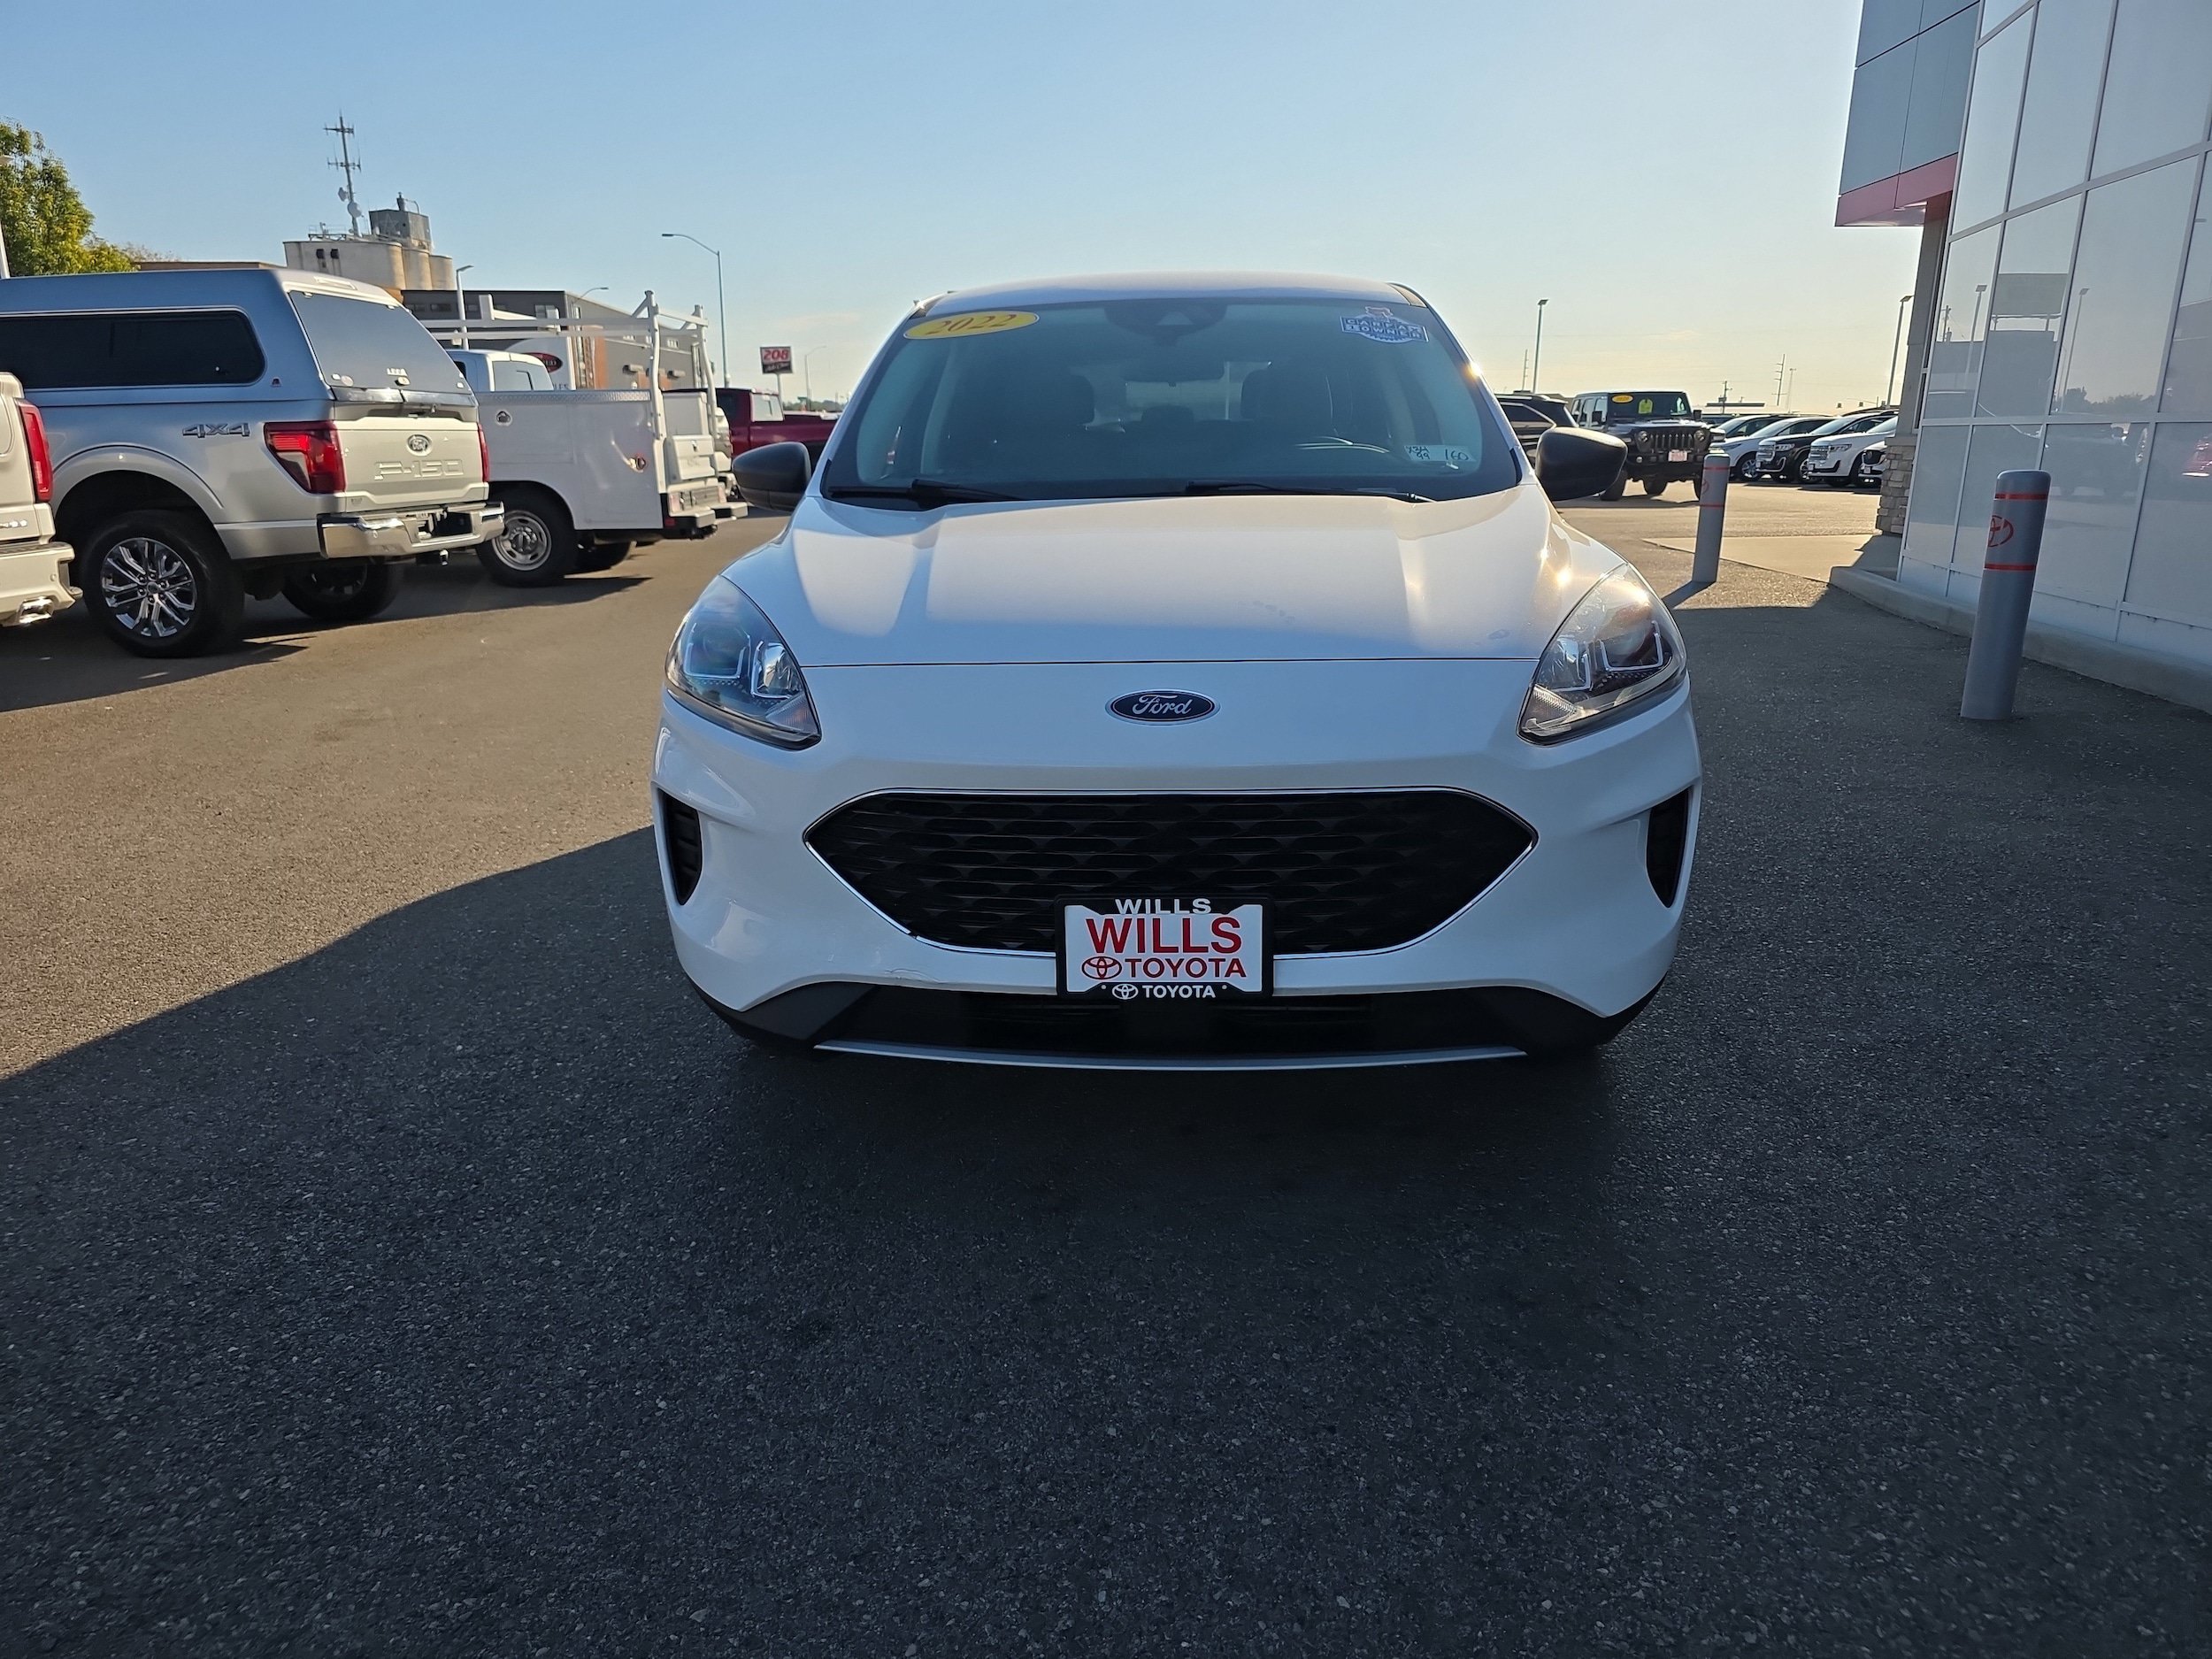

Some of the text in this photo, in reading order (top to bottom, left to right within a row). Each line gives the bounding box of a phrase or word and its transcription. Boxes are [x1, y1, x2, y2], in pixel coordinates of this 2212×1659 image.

[925, 314, 1017, 335] 2022
[1347, 319, 1421, 332] CARFAX
[1361, 326, 1420, 338] OWNER
[764, 349, 789, 361] 208
[1445, 449, 1470, 461] 160
[374, 460, 464, 480] F-150
[1132, 694, 1194, 715] Ford
[1115, 898, 1211, 915] WILLS
[1085, 917, 1242, 954] WILLS
[1124, 957, 1247, 978] TOYOTA
[1141, 985, 1216, 998] TOYOTA
